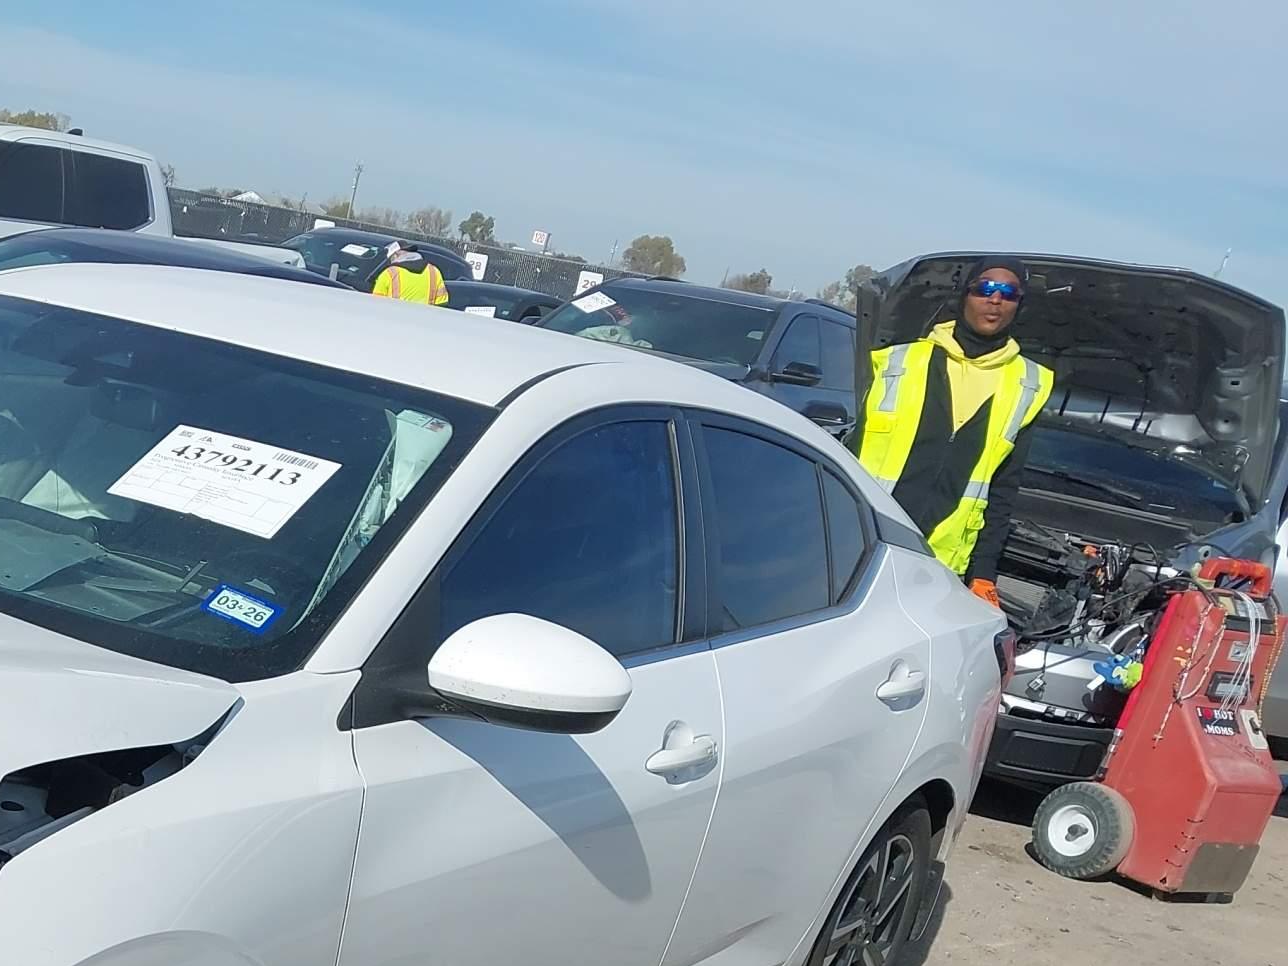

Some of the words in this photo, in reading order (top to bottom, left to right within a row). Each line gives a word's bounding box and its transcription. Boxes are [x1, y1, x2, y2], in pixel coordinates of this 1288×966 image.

[171, 445, 301, 485] 43792113
[217, 596, 239, 610] 03
[243, 607, 267, 622] 26
[1206, 724, 1235, 736] MOMS
